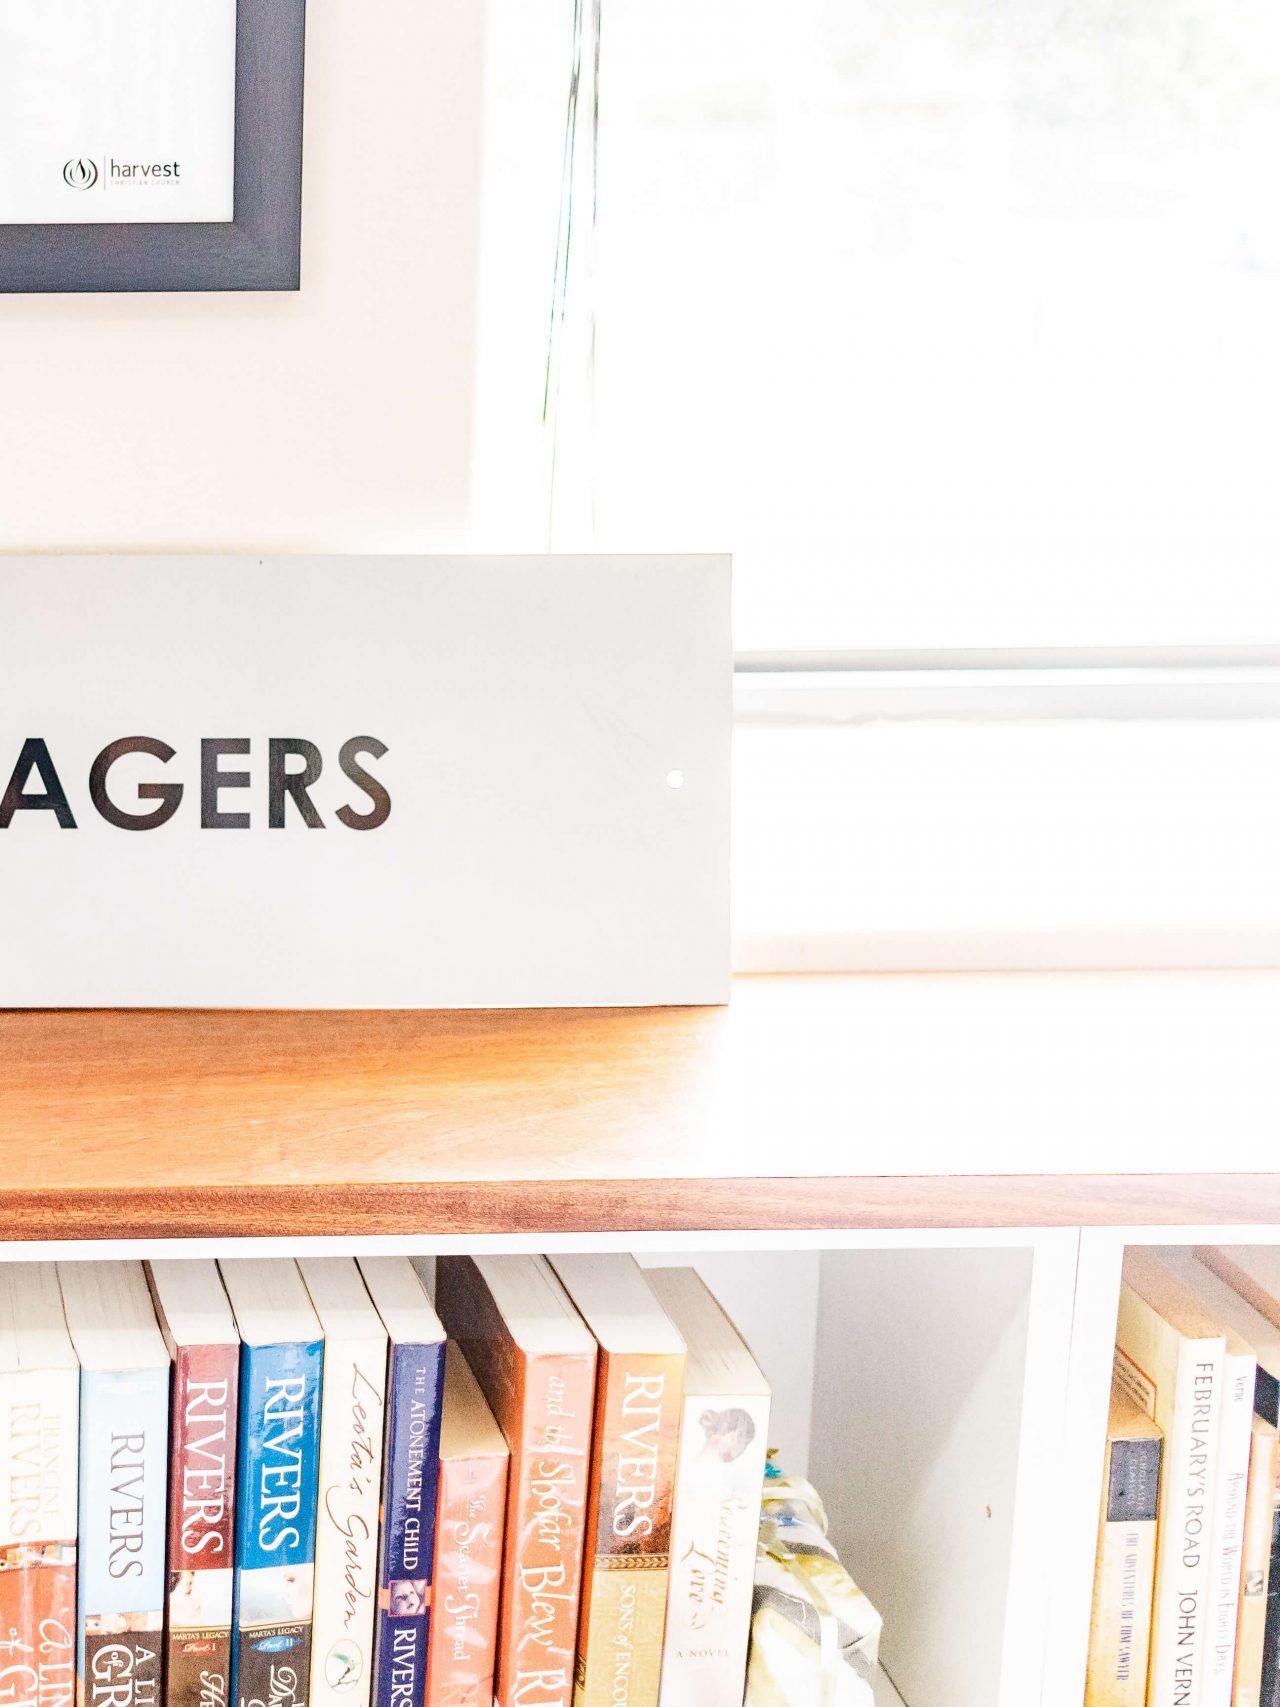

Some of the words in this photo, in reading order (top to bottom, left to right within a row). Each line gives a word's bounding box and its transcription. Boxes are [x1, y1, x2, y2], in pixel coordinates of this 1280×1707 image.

[111, 158, 180, 177] harvest
[415, 1366, 427, 1395] THE
[546, 1375, 577, 1418] and
[1234, 1375, 1246, 1403] Verne
[350, 1361, 383, 1497] Leota's
[406, 1399, 426, 1513] ATONEMENT
[612, 1371, 666, 1538] RIVERS
[1183, 1362, 1214, 1497] FEBRUARY'S
[9, 1401, 42, 1538] RIVERS
[43, 1415, 62, 1520] FRANCINE
[181, 1377, 228, 1555] RIVERS
[258, 1375, 306, 1553] RIVERS
[108, 1431, 146, 1579] RIVERS
[468, 1494, 486, 1519] The
[529, 1460, 573, 1552] Shofar
[325, 1484, 373, 1632] Garden
[402, 1516, 420, 1572] CHILD
[452, 1520, 489, 1593] Scarlet
[1182, 1505, 1203, 1569] ROAD
[681, 1540, 720, 1606] Love
[172, 1632, 200, 1641] MARTA'S
[202, 1631, 230, 1640] LEGACY
[249, 1629, 278, 1638] MARTA'S
[280, 1626, 304, 1635] LEGACY
[444, 1593, 480, 1662] Thread
[518, 1563, 576, 1649] Blew
[618, 1584, 637, 1631] SONS
[1177, 1589, 1198, 1646] JOHN
[103, 1651, 124, 1667] of
[135, 1645, 156, 1667] A
[285, 1639, 293, 1647] II
[612, 1633, 635, 1650] of
[676, 1649, 683, 1659] A
[688, 1648, 729, 1659] NOVEL
[1173, 1653, 1194, 1706] VERN
